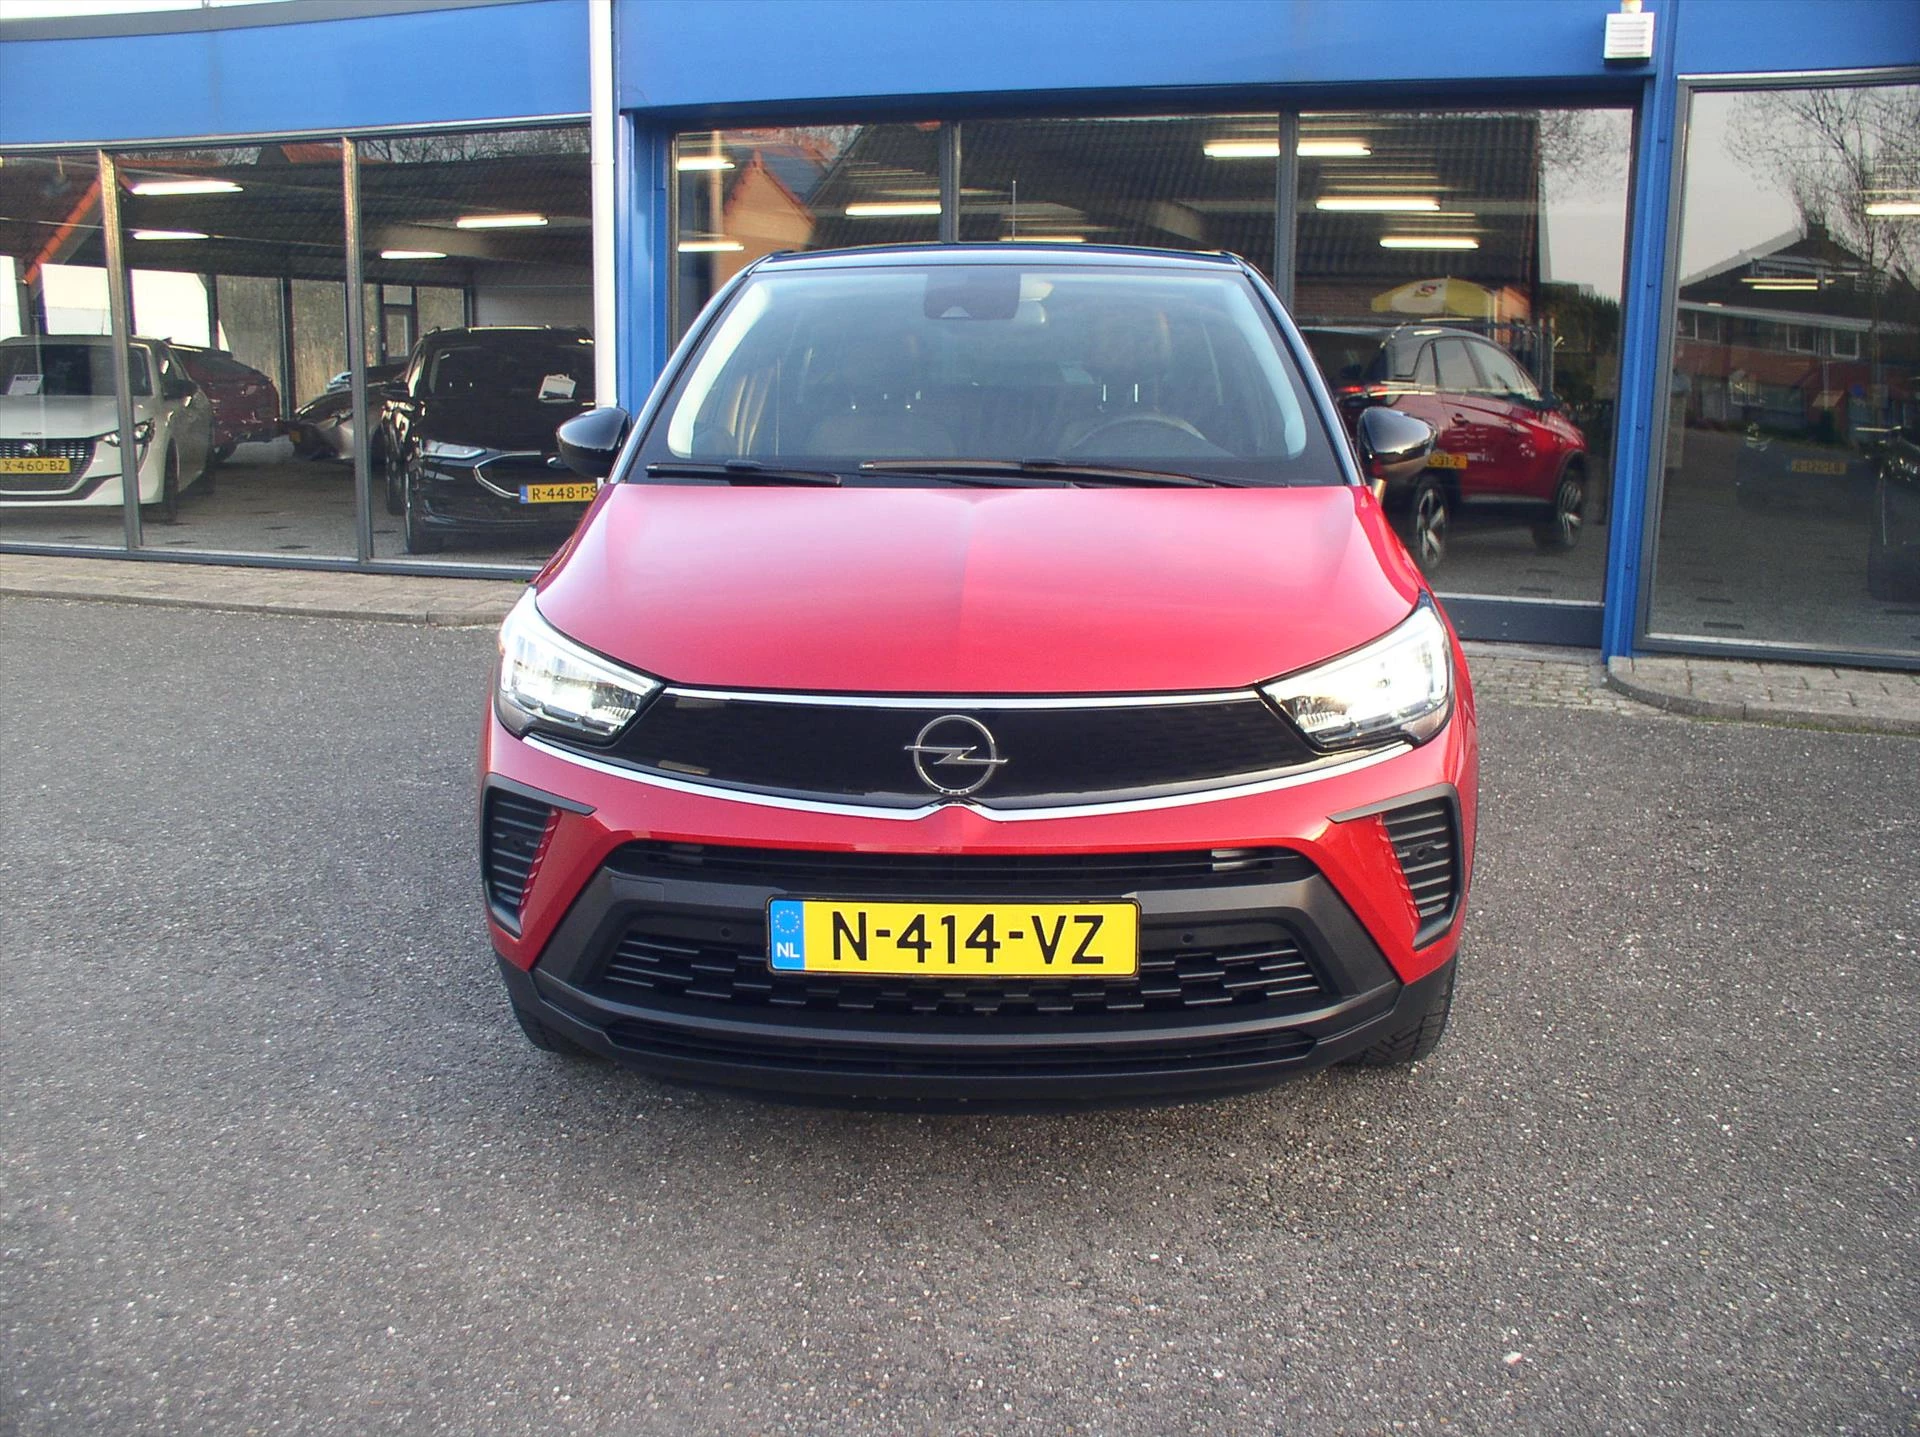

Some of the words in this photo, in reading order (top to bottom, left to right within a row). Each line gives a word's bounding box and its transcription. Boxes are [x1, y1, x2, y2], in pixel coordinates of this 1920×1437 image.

[4, 460, 66, 472] X-460-BZ
[832, 911, 1104, 965] N-414-VZ
[776, 941, 800, 958] NL
